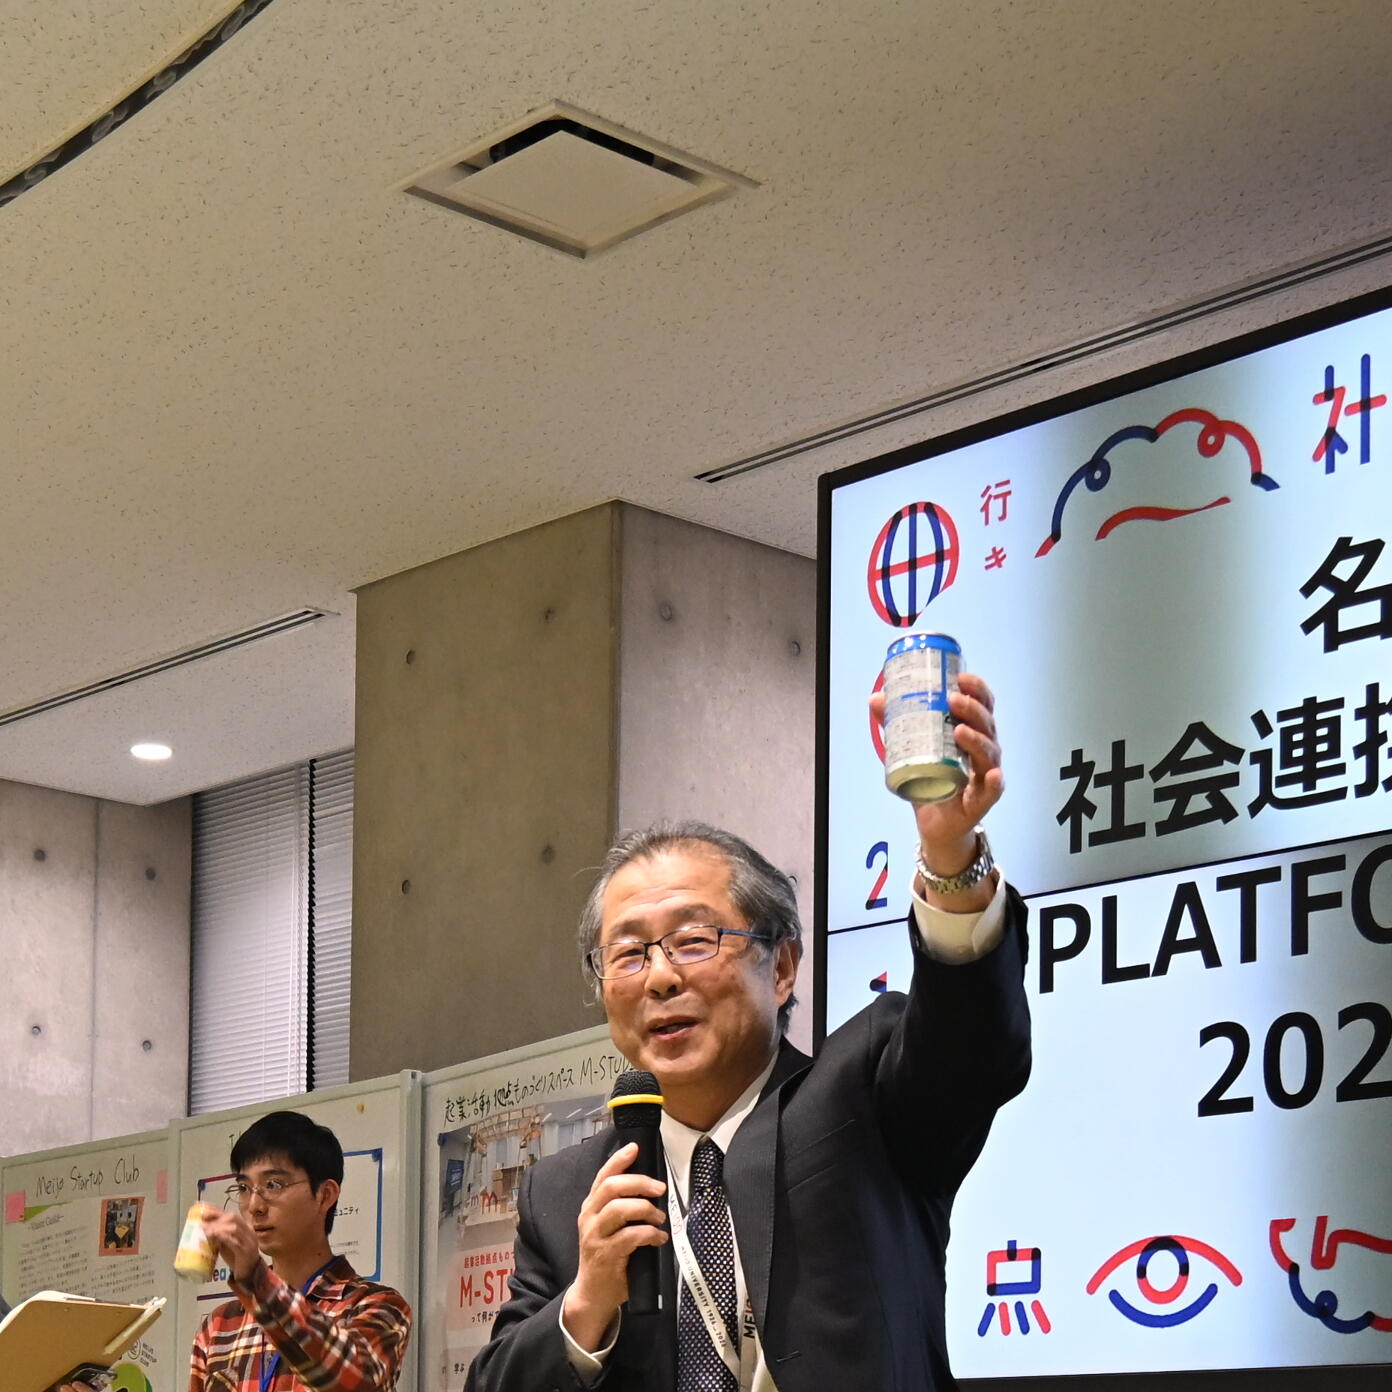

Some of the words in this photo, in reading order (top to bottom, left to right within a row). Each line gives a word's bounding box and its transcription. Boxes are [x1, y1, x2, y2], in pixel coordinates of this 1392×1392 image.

[113, 1153, 140, 1185] Club
[459, 1268, 512, 1308] M-ST
[687, 1267, 710, 1308] UNIVERSITY
